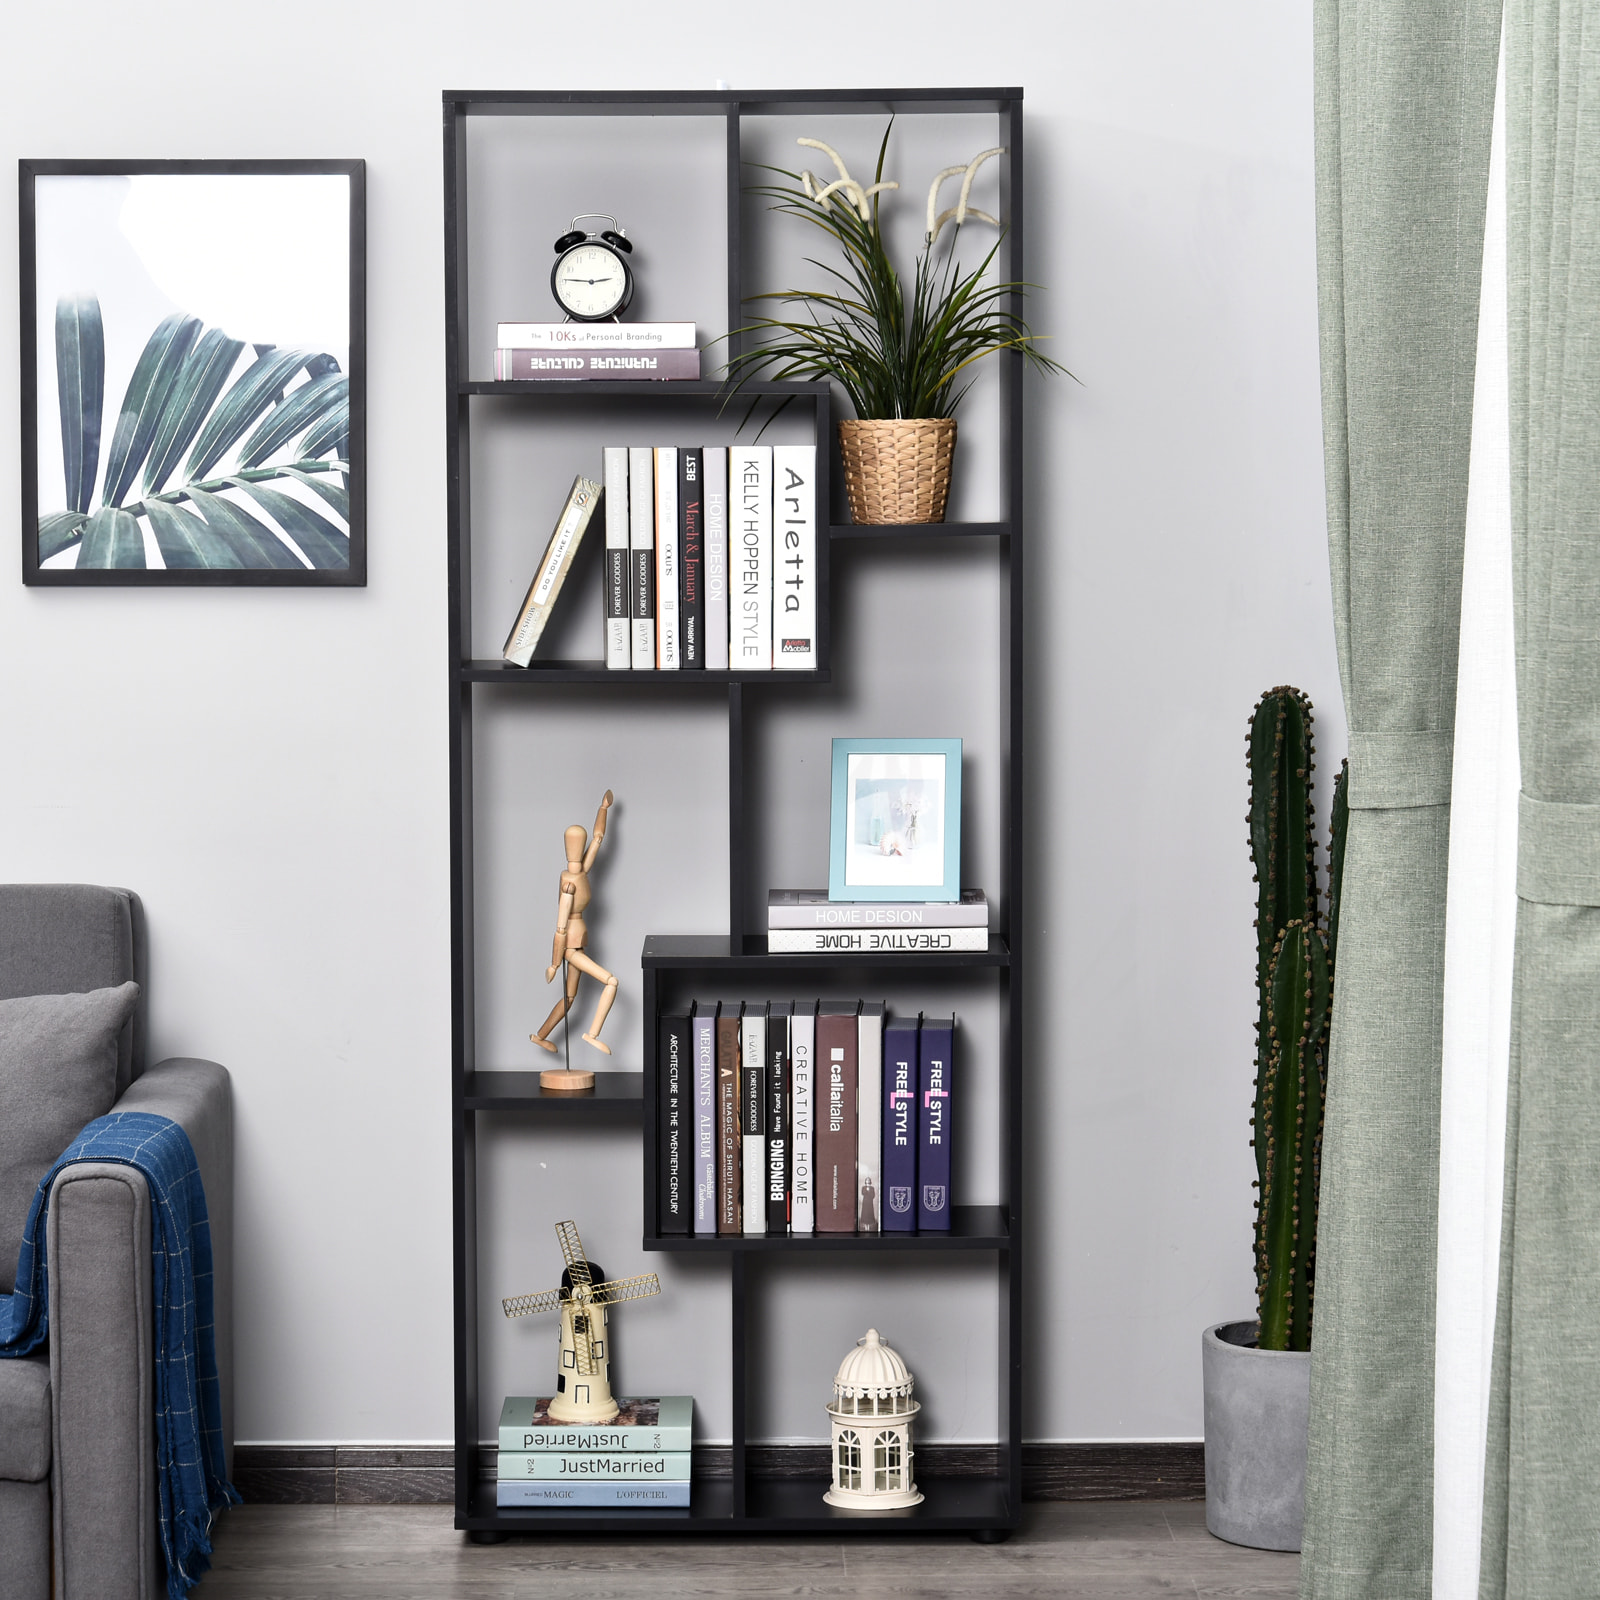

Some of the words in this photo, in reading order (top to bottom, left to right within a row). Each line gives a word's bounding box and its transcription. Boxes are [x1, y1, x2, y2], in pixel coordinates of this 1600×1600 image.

[549, 331, 577, 342] 10Ks
[586, 333, 623, 341] Personal
[626, 333, 662, 342] Branding
[530, 357, 585, 369] CULTURE
[590, 357, 658, 369] FURNITURE
[686, 455, 696, 481] BEST
[743, 461, 759, 514] KELLY
[686, 502, 699, 540] March
[709, 494, 722, 538] HOME
[686, 544, 699, 554] &
[743, 521, 759, 594] HOPPEN
[785, 467, 806, 612] Arletta
[542, 578, 550, 591] DO
[548, 559, 559, 576] YOU
[556, 539, 566, 560] LIKE
[564, 529, 571, 538] IT
[613, 553, 621, 585] GODDESS
[684, 556, 699, 604] January
[515, 607, 536, 646] SIDESHOW
[687, 616, 695, 643] ARRIVAL
[743, 601, 758, 656] STYLE
[687, 644, 695, 660] NEW
[815, 910, 861, 923] HOME
[816, 935, 861, 949] HOME
[870, 935, 951, 949] CREATIVE
[669, 1034, 678, 1094] ARCHITECTURE
[700, 1028, 711, 1106] MERCHANTS
[774, 1051, 782, 1078] lacking
[895, 1062, 908, 1098] FREE
[930, 1061, 942, 1097] FREE
[670, 1098, 678, 1107] IN
[796, 1045, 807, 1140] CREATIVE
[829, 1064, 844, 1131] caliaitalia
[670, 1111, 678, 1126] THE
[700, 1114, 711, 1158] ALBUM
[895, 1101, 908, 1146] STYLE
[929, 1100, 942, 1144] STYLE
[670, 1130, 678, 1175] TWENTIETH
[726, 1138, 733, 1150] OF
[771, 1139, 784, 1201] BRINGING
[796, 1153, 807, 1204] HOME
[670, 1176, 678, 1214] CENTURY
[524, 1434, 629, 1448] JustMarried
[559, 1458, 665, 1473] JustMarried
[543, 1491, 574, 1499] MAGIC
[616, 1491, 667, 1499] L'OFFICIEL
